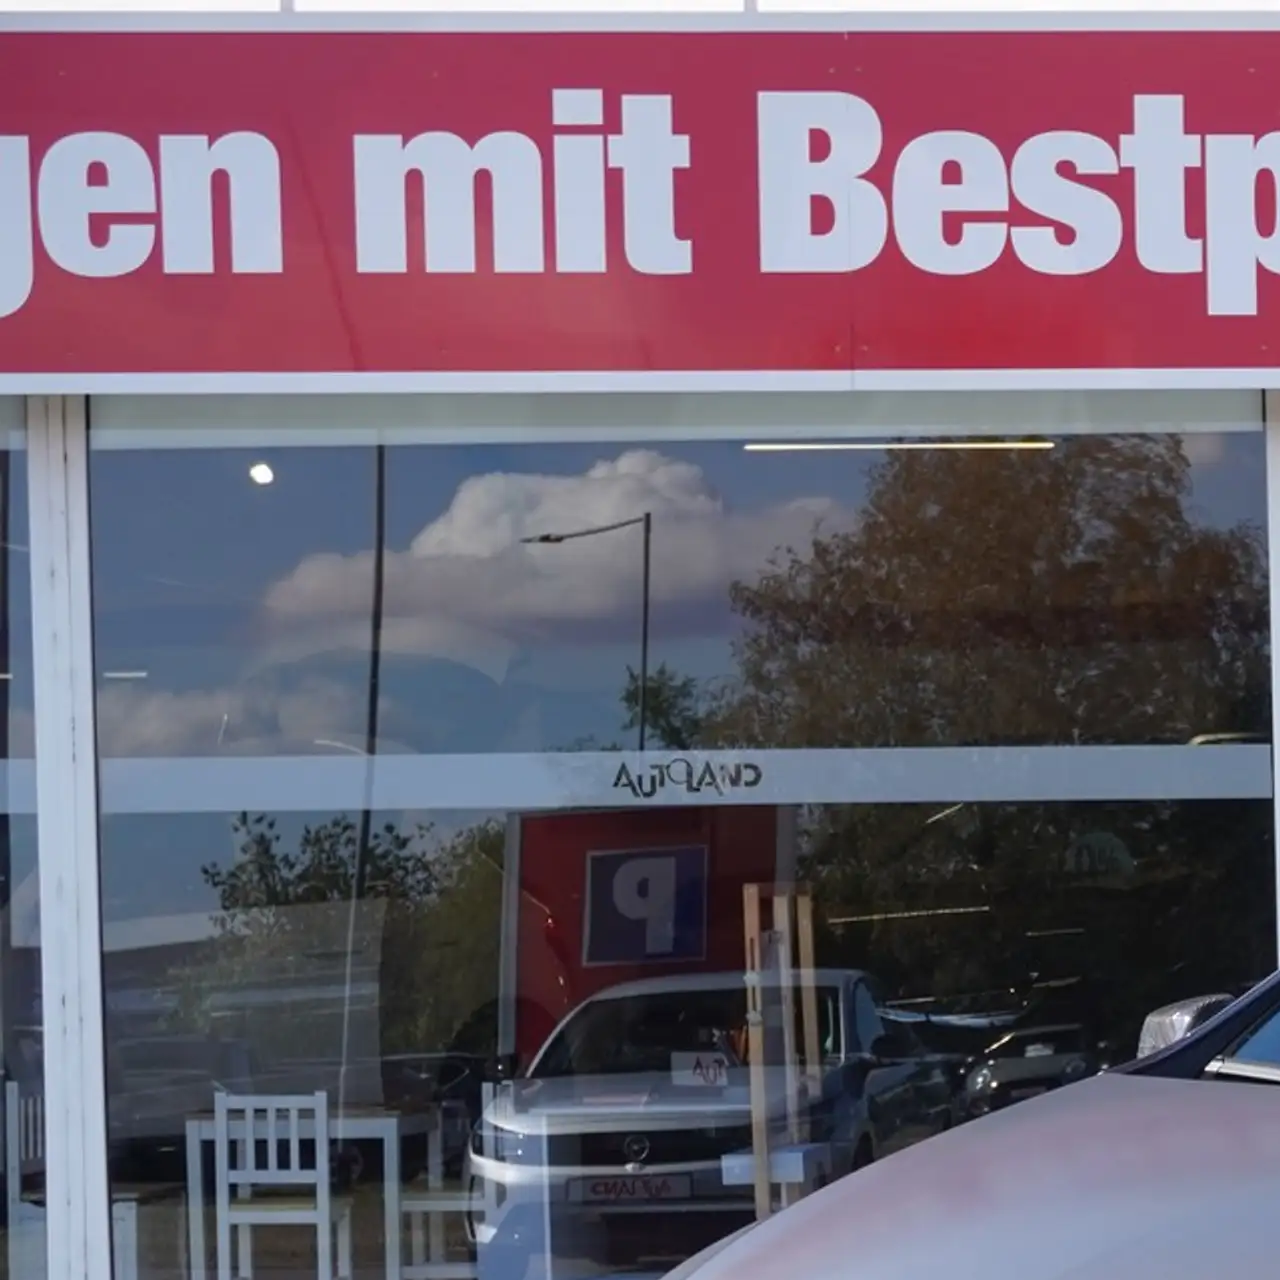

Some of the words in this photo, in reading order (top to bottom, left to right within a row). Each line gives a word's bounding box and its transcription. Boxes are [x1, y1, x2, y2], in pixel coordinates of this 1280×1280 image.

[0, 131, 283, 317] en
[353, 88, 693, 274] mit
[612, 758, 763, 799] AUTOLAND
